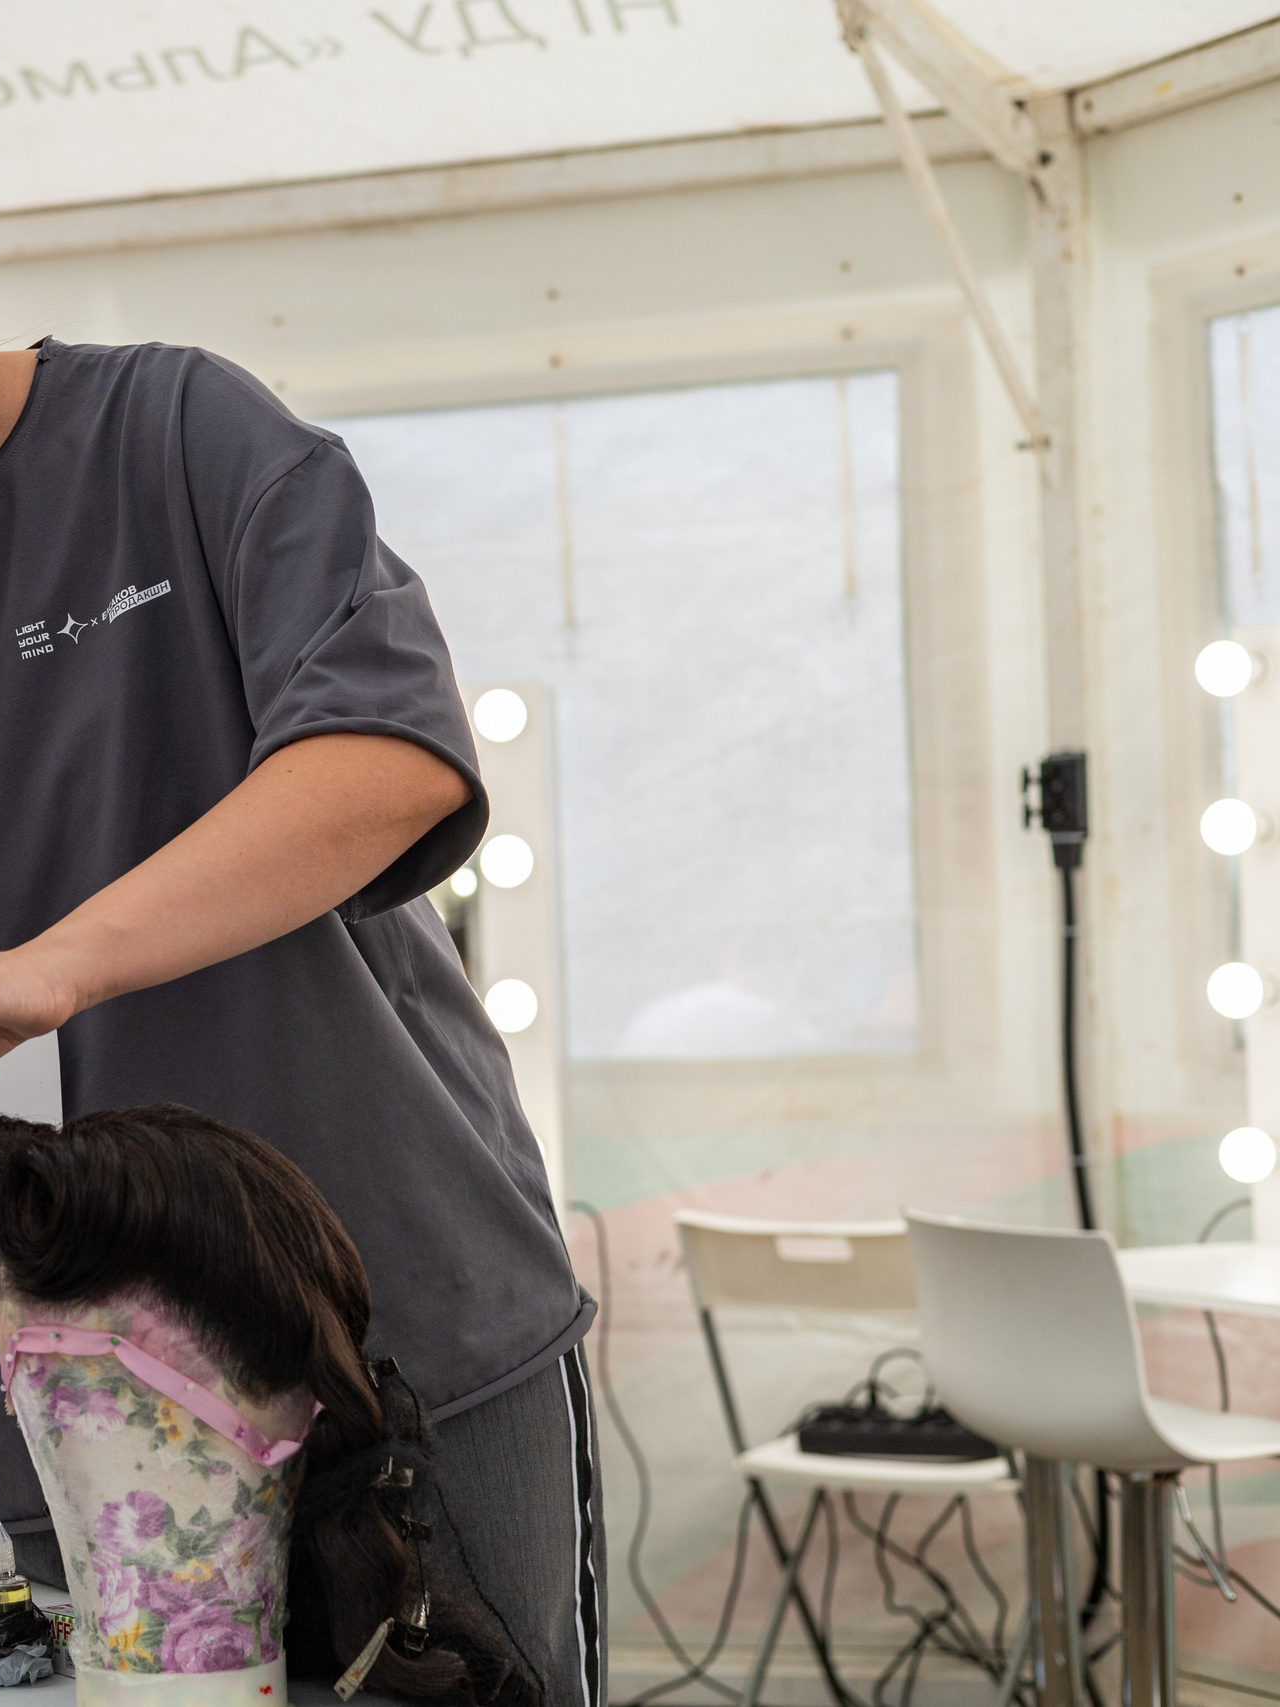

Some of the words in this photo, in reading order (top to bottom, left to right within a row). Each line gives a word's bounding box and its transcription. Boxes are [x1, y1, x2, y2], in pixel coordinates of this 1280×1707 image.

[109, 582, 169, 620] ПРОДАКШН
[15, 620, 46, 636] LIGHT
[18, 632, 51, 648] YOUR
[21, 644, 55, 660] MIND
